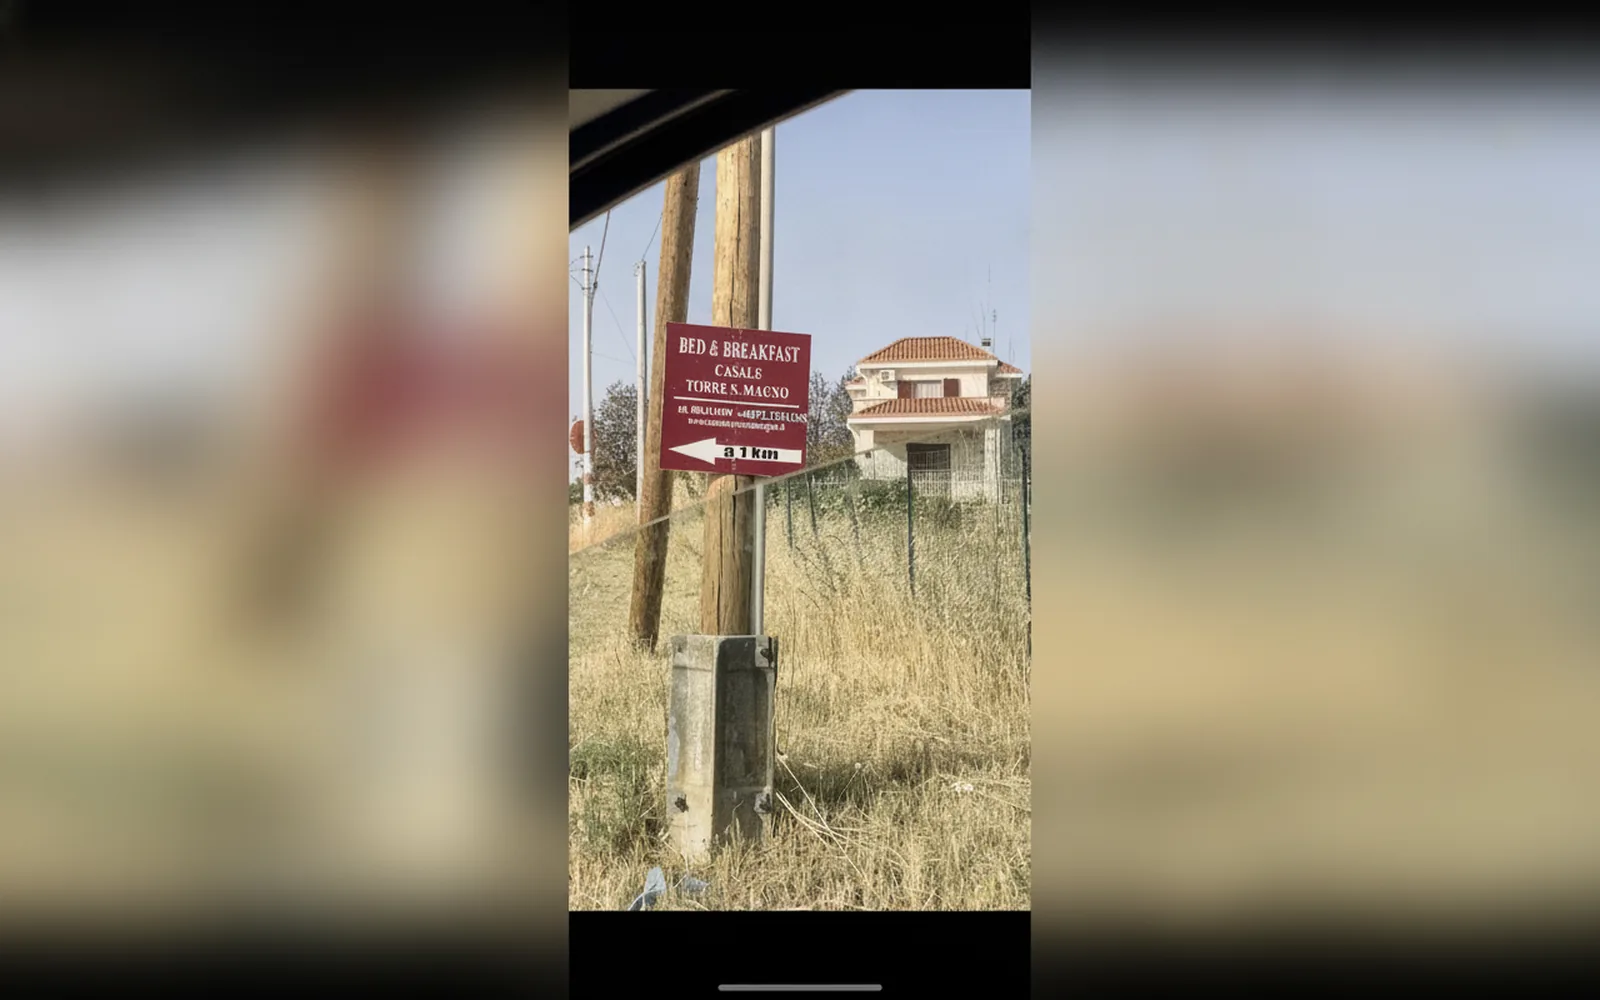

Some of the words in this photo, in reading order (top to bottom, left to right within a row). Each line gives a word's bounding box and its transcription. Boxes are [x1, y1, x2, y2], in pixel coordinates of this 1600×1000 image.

[679, 336, 706, 355] BED
[709, 339, 718, 356] &
[723, 341, 800, 363] BREAKFAST
[686, 379, 728, 395] TORRE
[724, 446, 734, 458] a
[740, 446, 747, 458] 1
